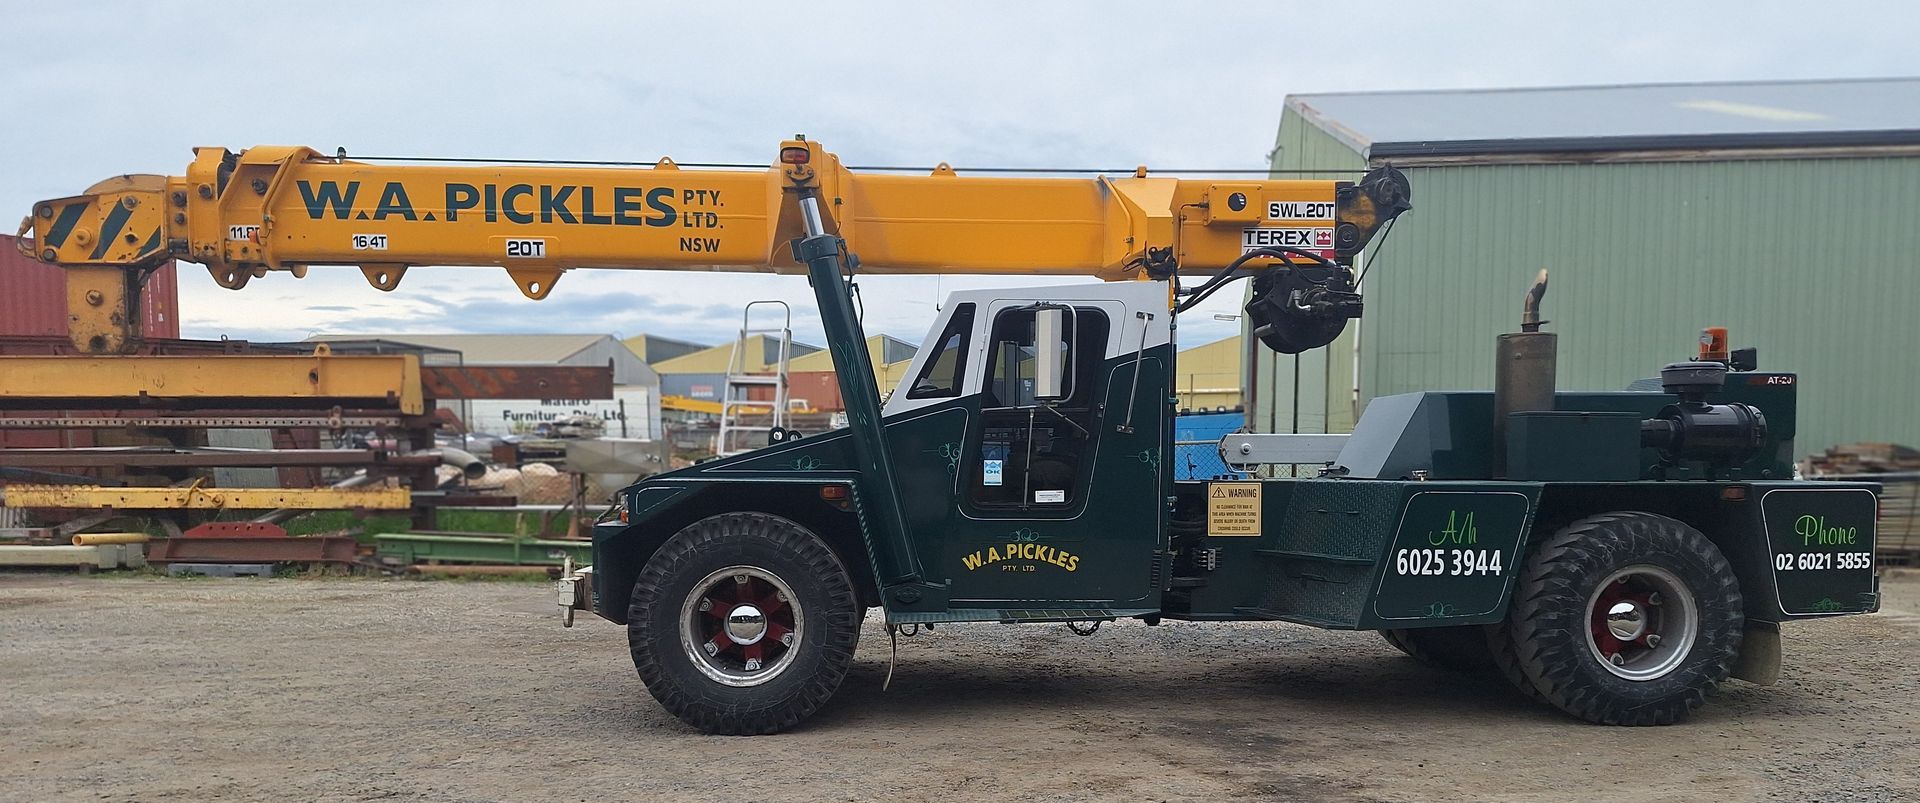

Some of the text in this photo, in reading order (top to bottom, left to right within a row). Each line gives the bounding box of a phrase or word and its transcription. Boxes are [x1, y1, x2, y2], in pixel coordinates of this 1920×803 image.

[683, 189, 724, 207] PTY.
[1269, 203, 1335, 218] SWL.20T
[683, 211, 724, 229] LTD.
[680, 237, 721, 253] NSW
[1244, 230, 1311, 246] TEREX
[507, 240, 544, 257] 20T
[503, 410, 566, 421] Furnitur
[1228, 488, 1257, 498] WARNING
[1428, 510, 1477, 546] A/h
[1795, 515, 1857, 546] Phone
[1396, 549, 1502, 576] 6025 3944
[1775, 552, 1871, 571] 02 6021 5855
